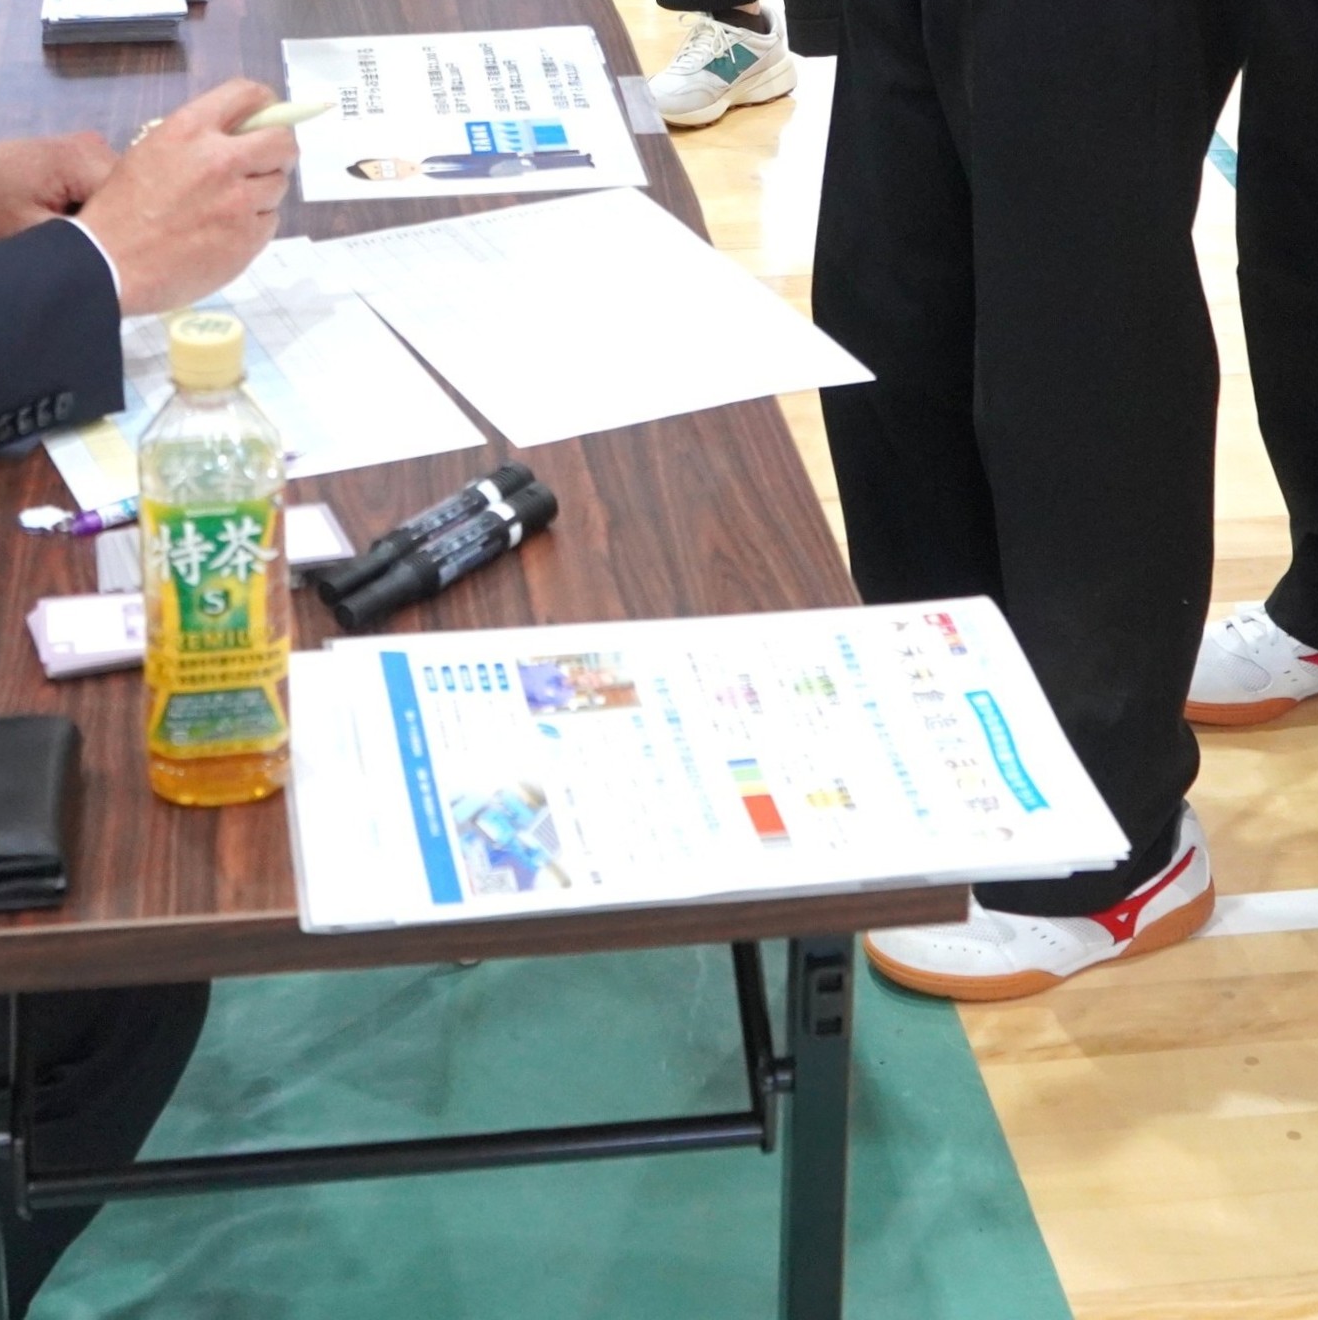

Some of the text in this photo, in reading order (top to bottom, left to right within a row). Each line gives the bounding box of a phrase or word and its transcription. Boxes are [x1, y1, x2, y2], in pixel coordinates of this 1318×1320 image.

[470, 124, 493, 152] BANK
[148, 515, 280, 588] 特茶
[203, 590, 226, 615] S
